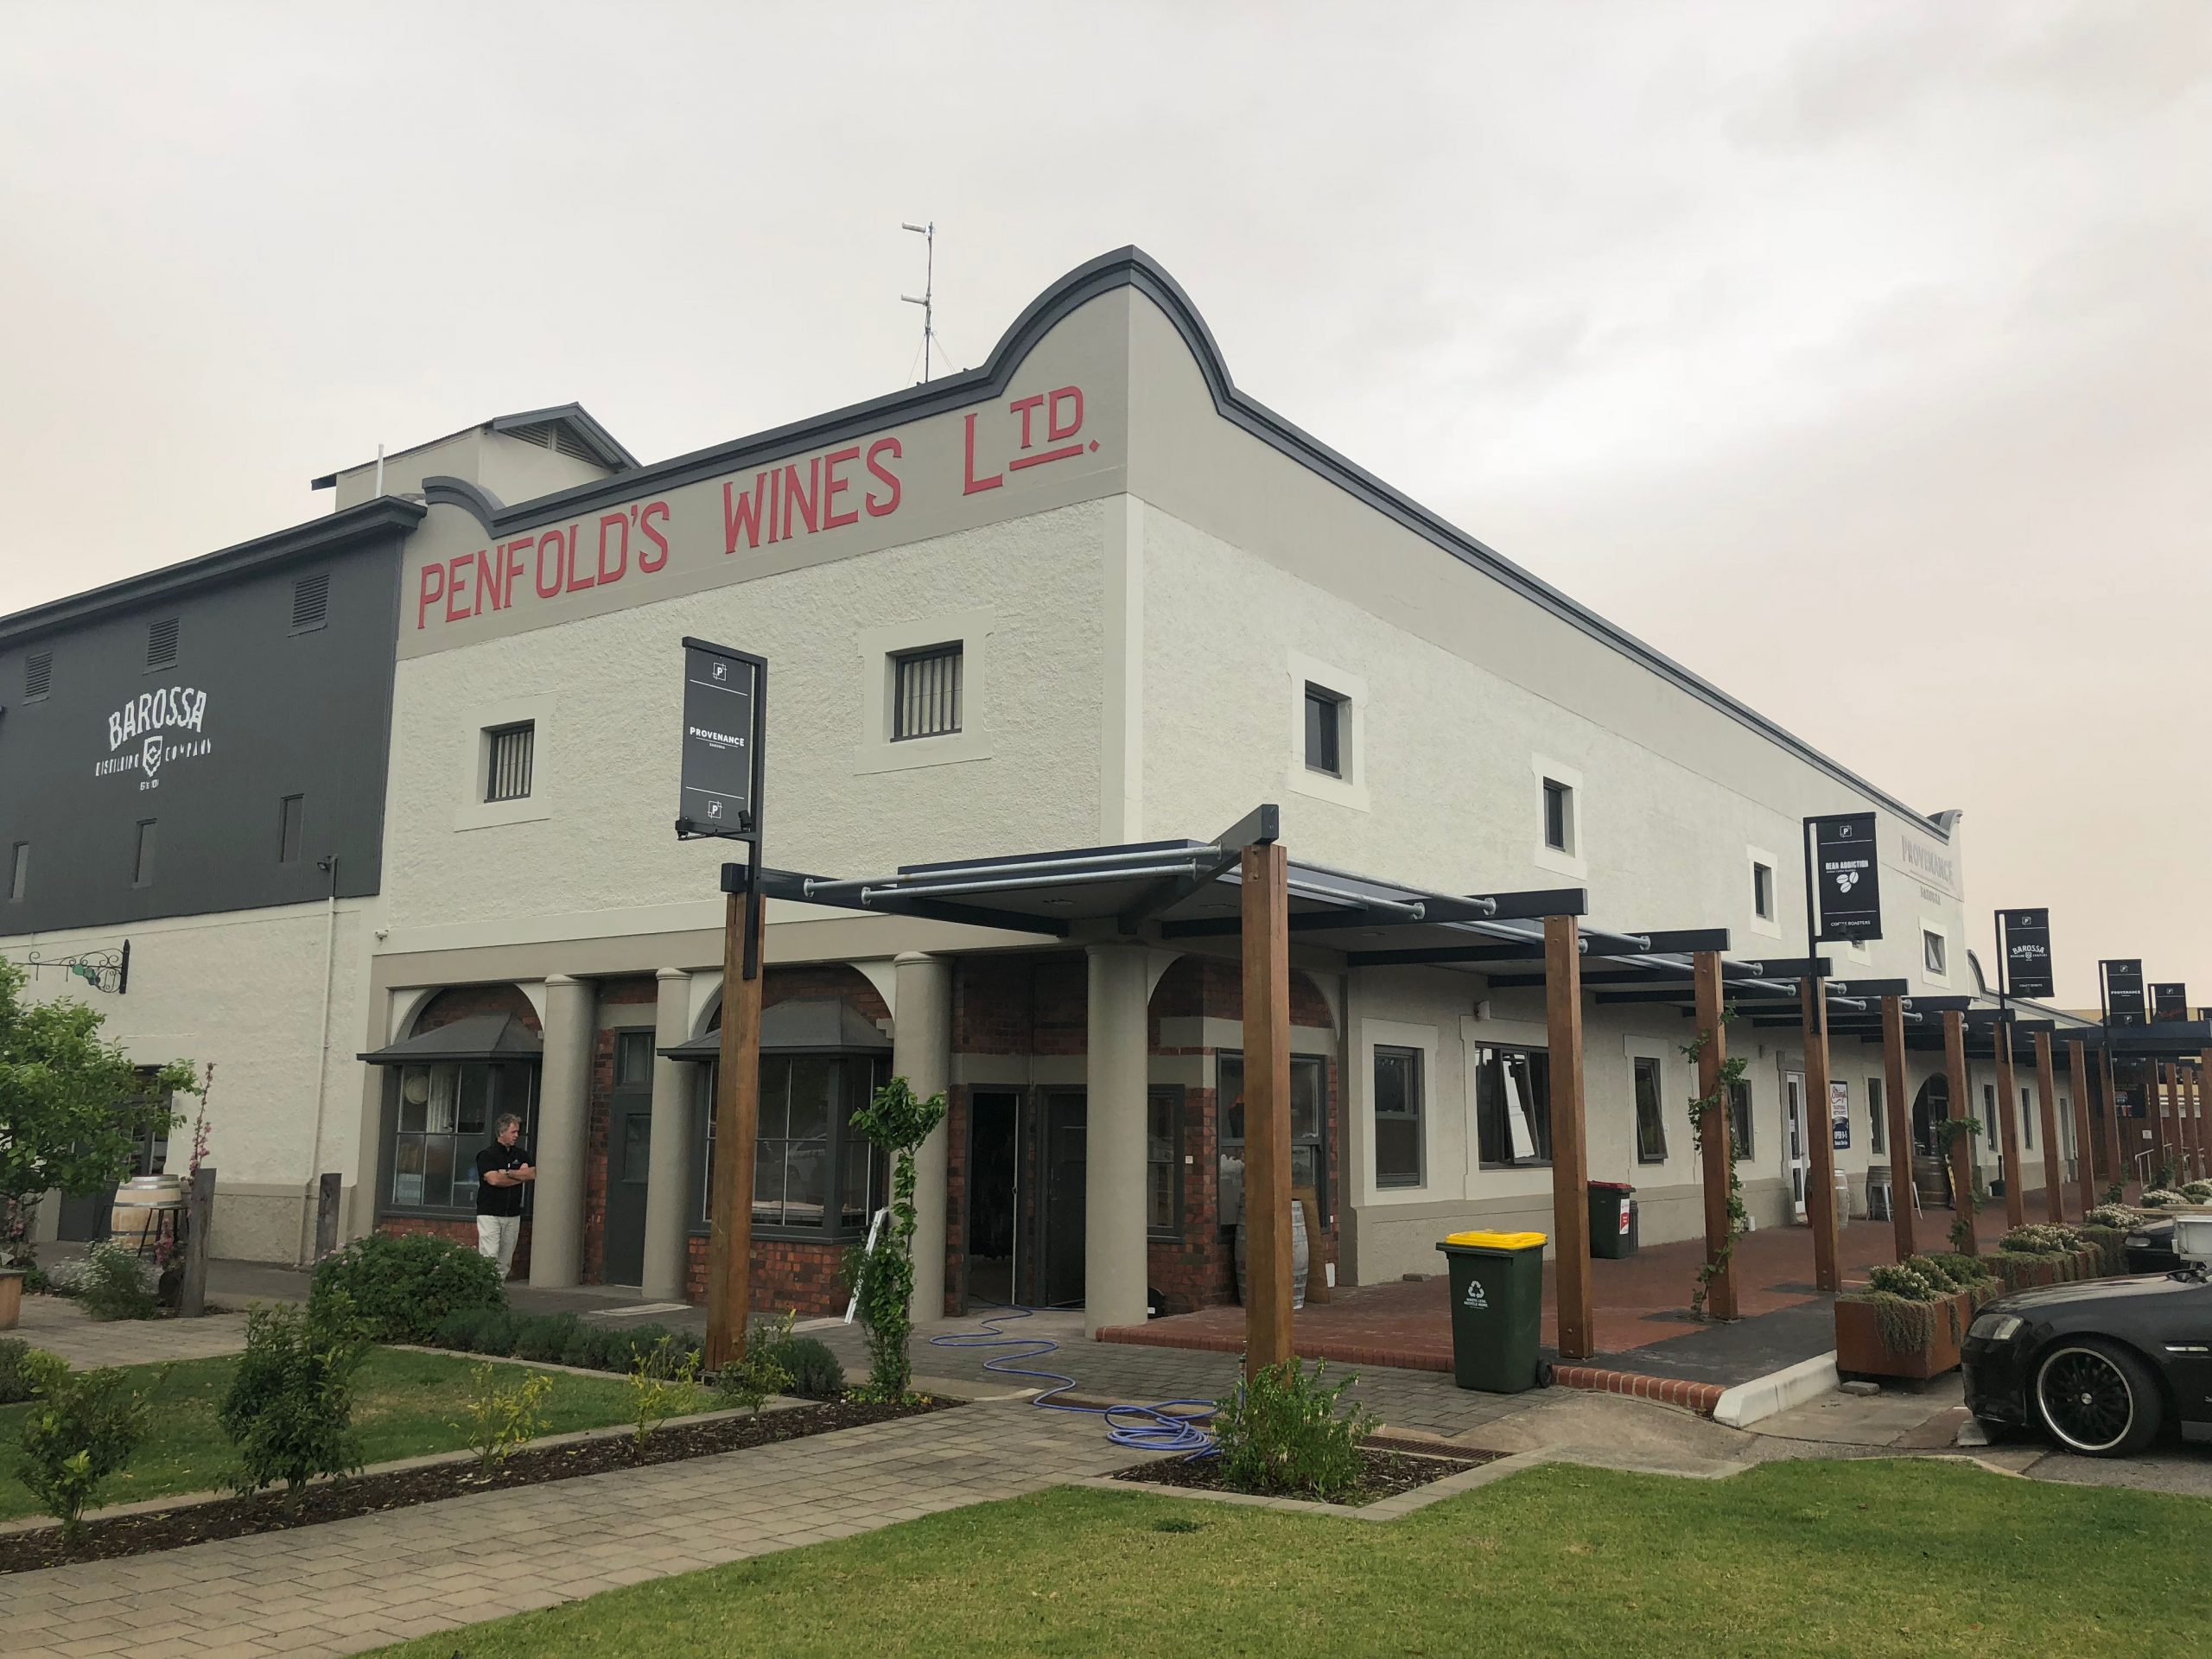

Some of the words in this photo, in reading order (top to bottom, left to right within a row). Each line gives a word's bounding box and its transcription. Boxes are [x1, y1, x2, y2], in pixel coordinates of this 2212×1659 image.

[417, 501, 671, 630] PENFOLD'S
[723, 437, 902, 554] WINES
[109, 687, 207, 752] BAROSSA
[690, 727, 745, 747] PROVENANCE
[1840, 860, 1869, 869] ADDICTION
[2012, 945, 2045, 955] BAROSSA
